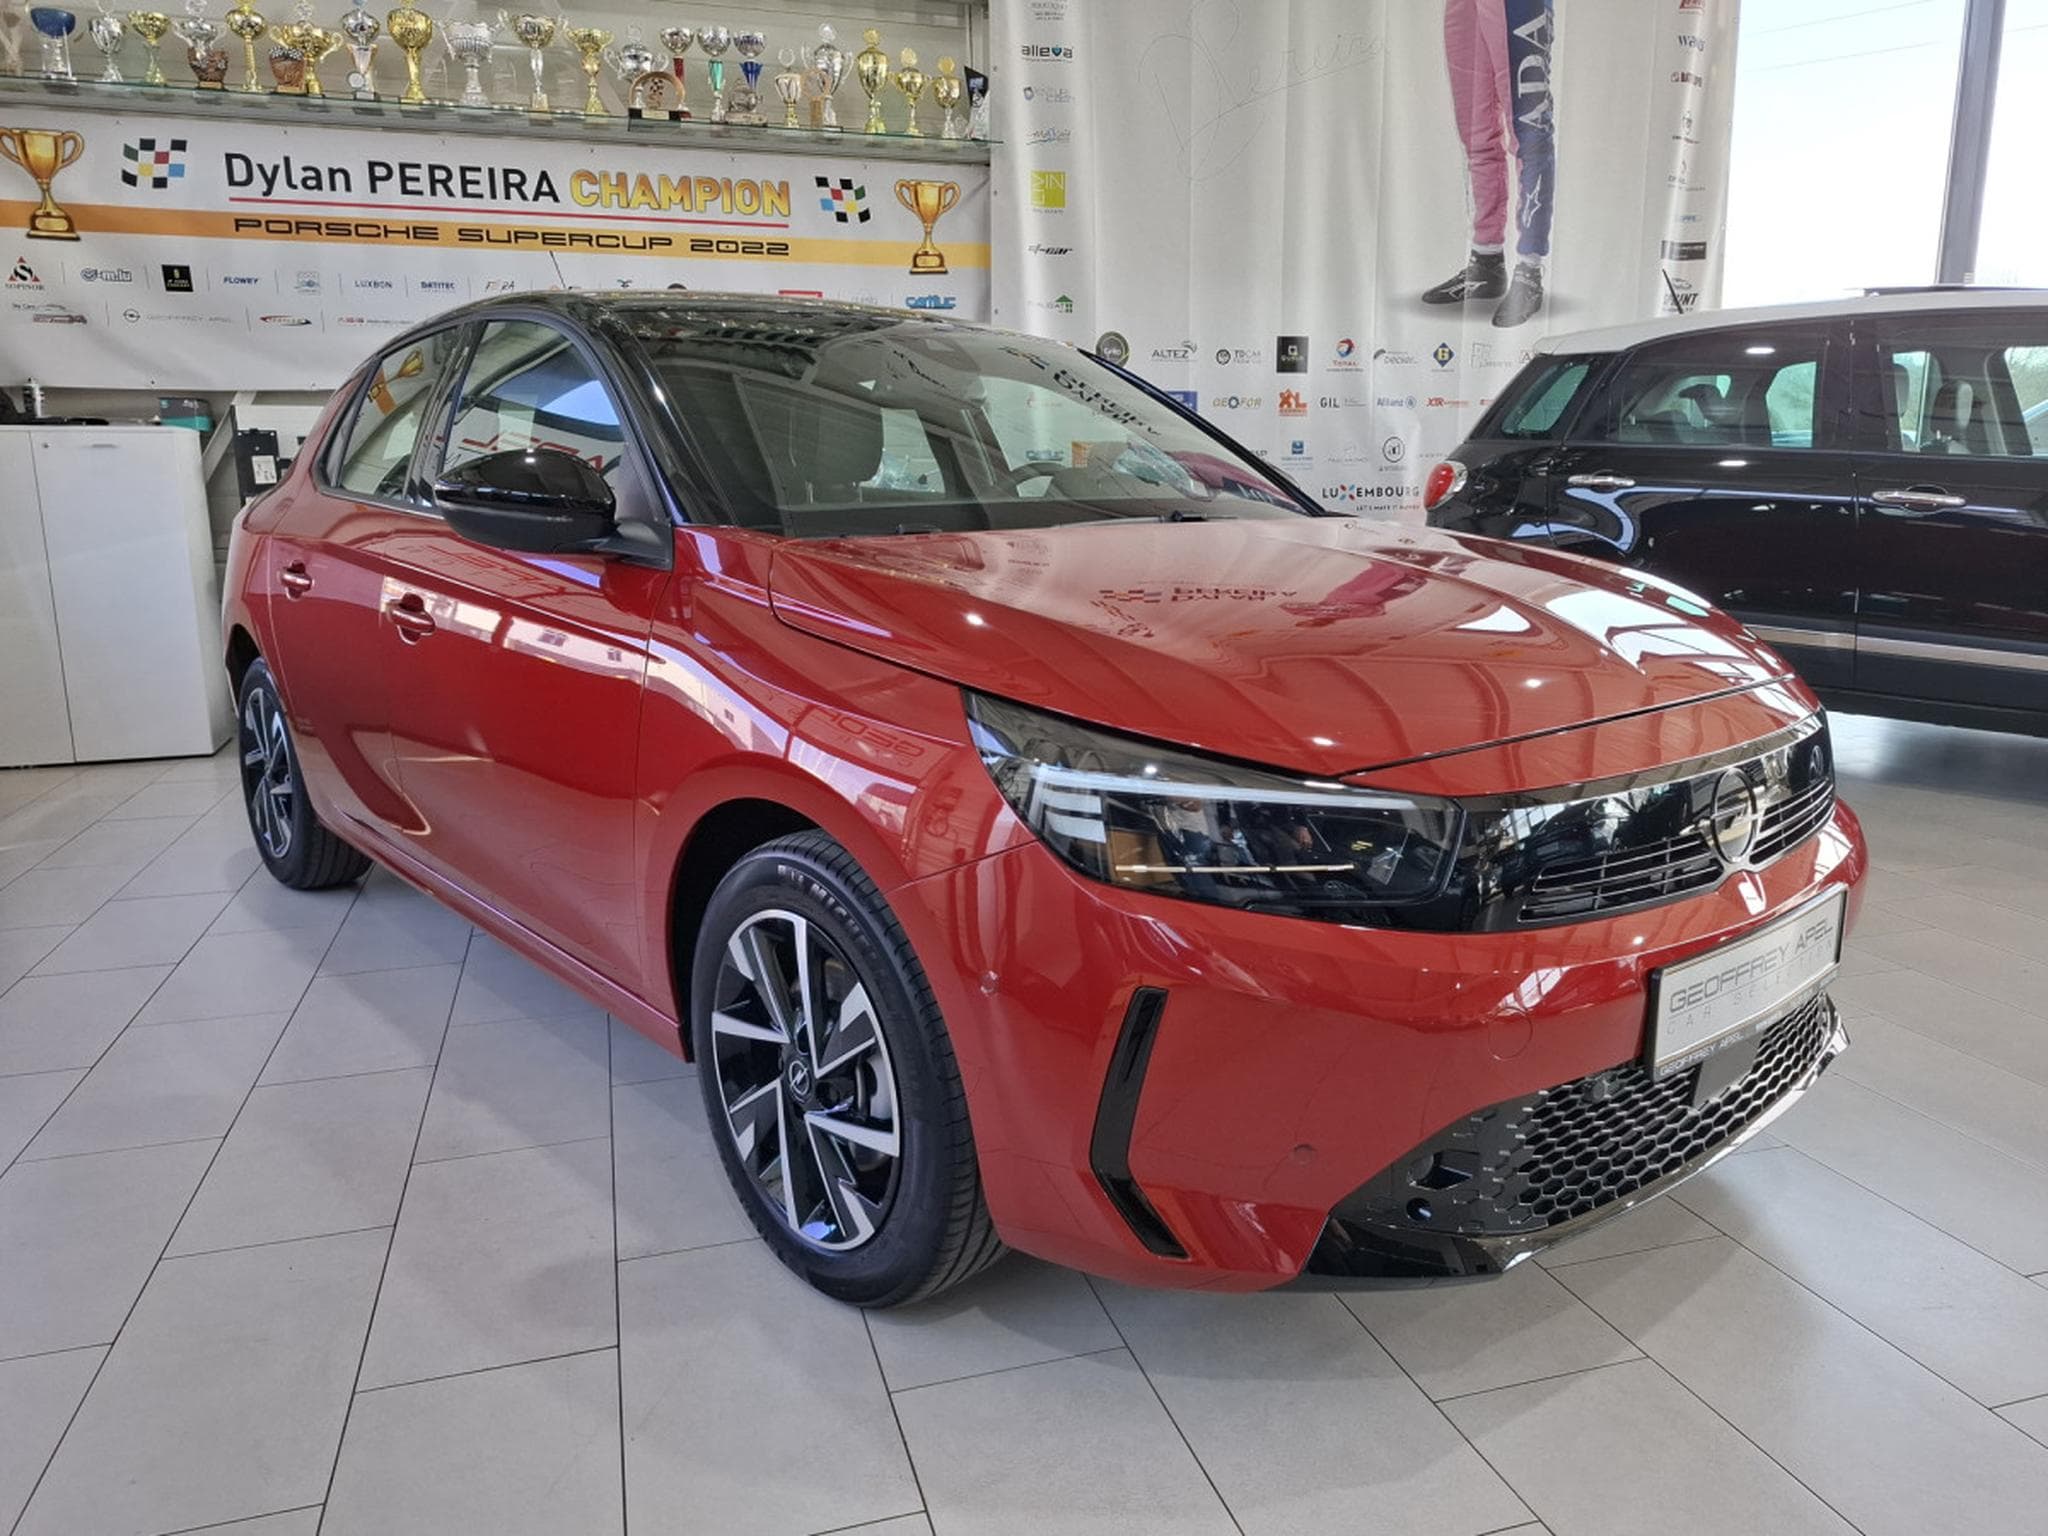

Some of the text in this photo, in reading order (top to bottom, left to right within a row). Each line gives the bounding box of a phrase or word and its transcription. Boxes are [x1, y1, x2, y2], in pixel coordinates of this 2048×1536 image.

[224, 152, 792, 217] Dylan PEREIRA CHAMPION
[233, 218, 790, 256] PORSCHE SUPERCUP 2022
[1152, 350, 1189, 359] ALTEZ
[1320, 396, 1340, 408] GIL
[1321, 484, 1420, 500] LUXEMBOURG
[1669, 919, 1833, 1014] GEOFFREY APEL
